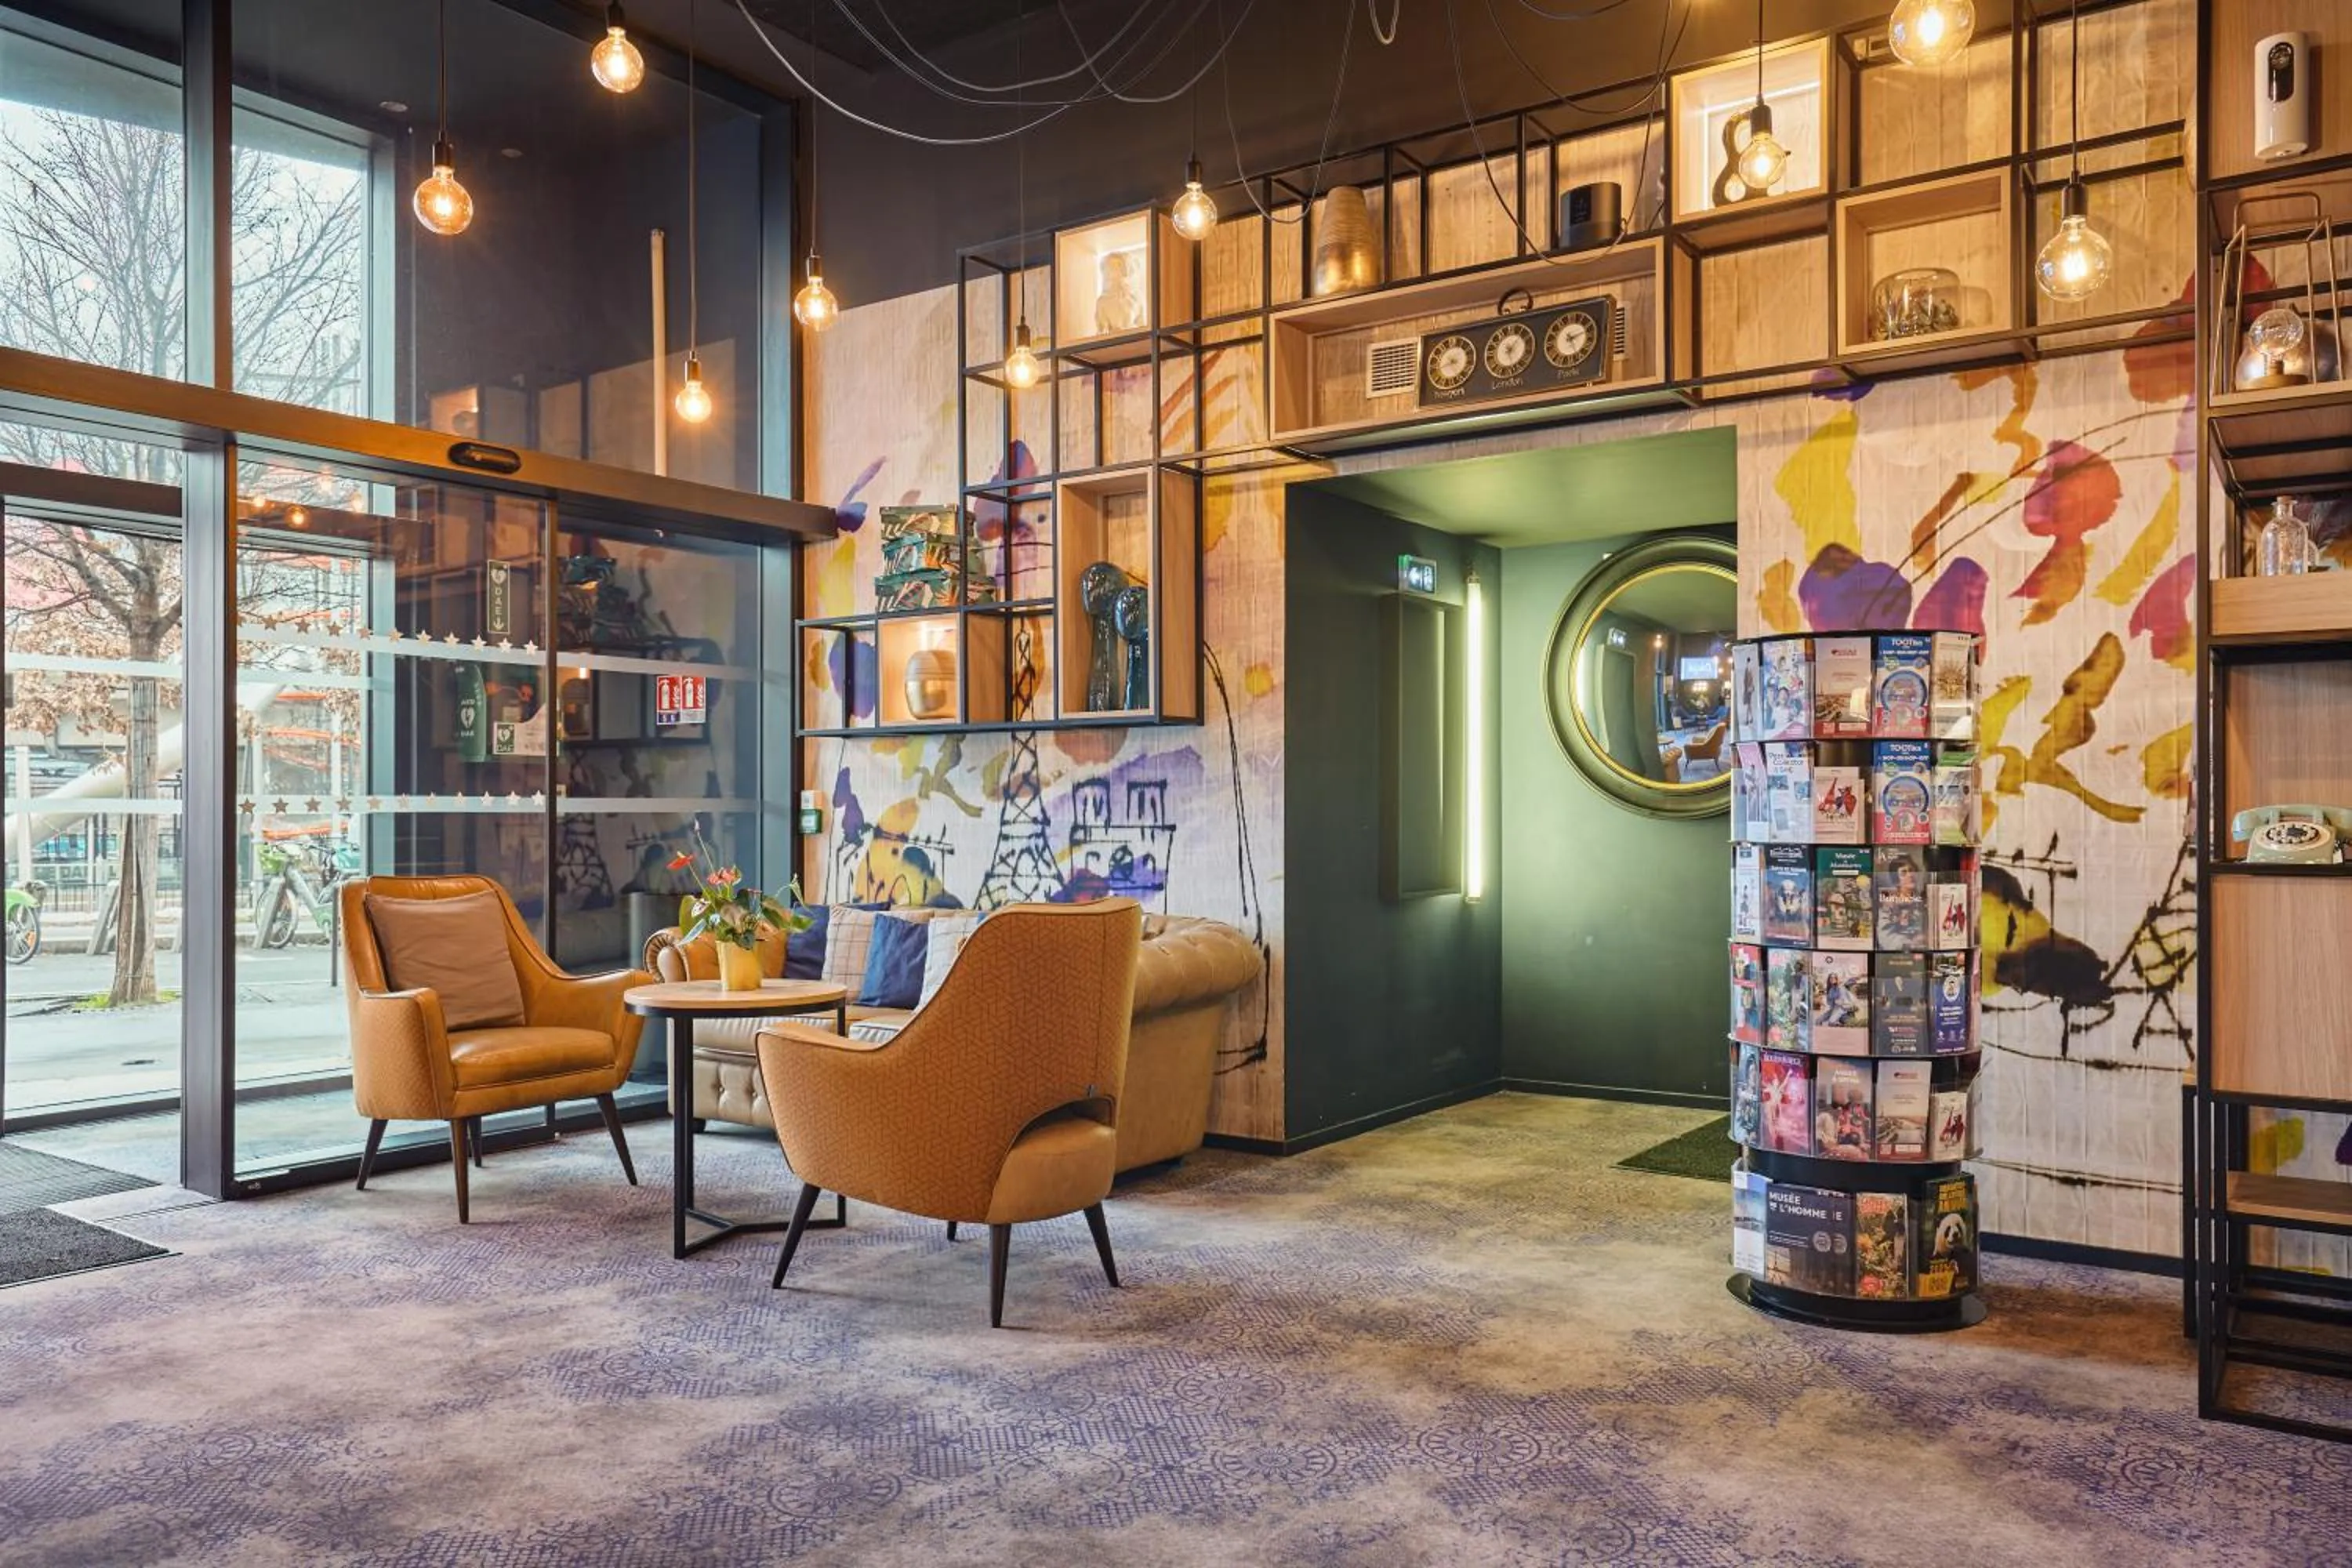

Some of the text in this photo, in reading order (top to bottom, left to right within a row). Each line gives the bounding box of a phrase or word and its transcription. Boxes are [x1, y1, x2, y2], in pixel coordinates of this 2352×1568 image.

[1492, 376, 1524, 390] London
[1769, 1191, 1802, 1205] MUSÉE
[1779, 1203, 1828, 1220] L'HOMME
